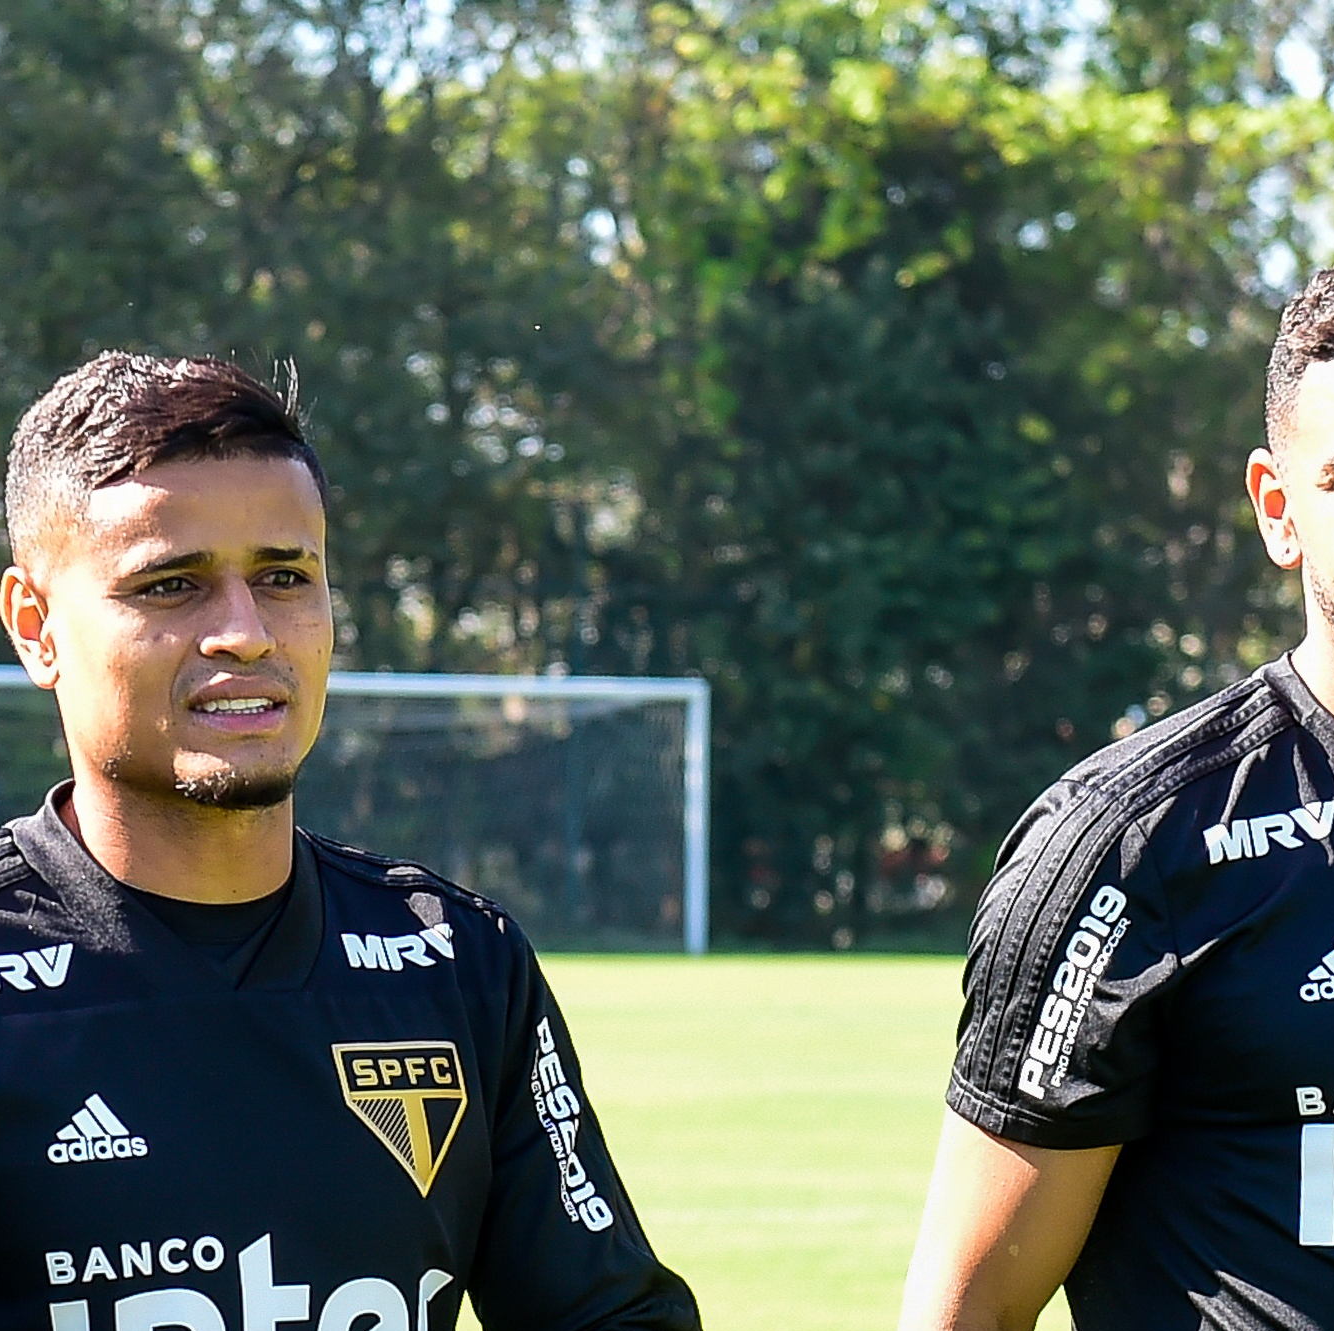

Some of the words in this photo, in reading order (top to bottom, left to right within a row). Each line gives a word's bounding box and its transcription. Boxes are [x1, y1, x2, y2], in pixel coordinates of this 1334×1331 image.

[341, 923, 455, 971] MRV
[1018, 885, 1128, 1100] PES2019
[352, 1057, 452, 1086] SPFC
[47, 1135, 148, 1163] adidas
[45, 1235, 224, 1285] BANCO
